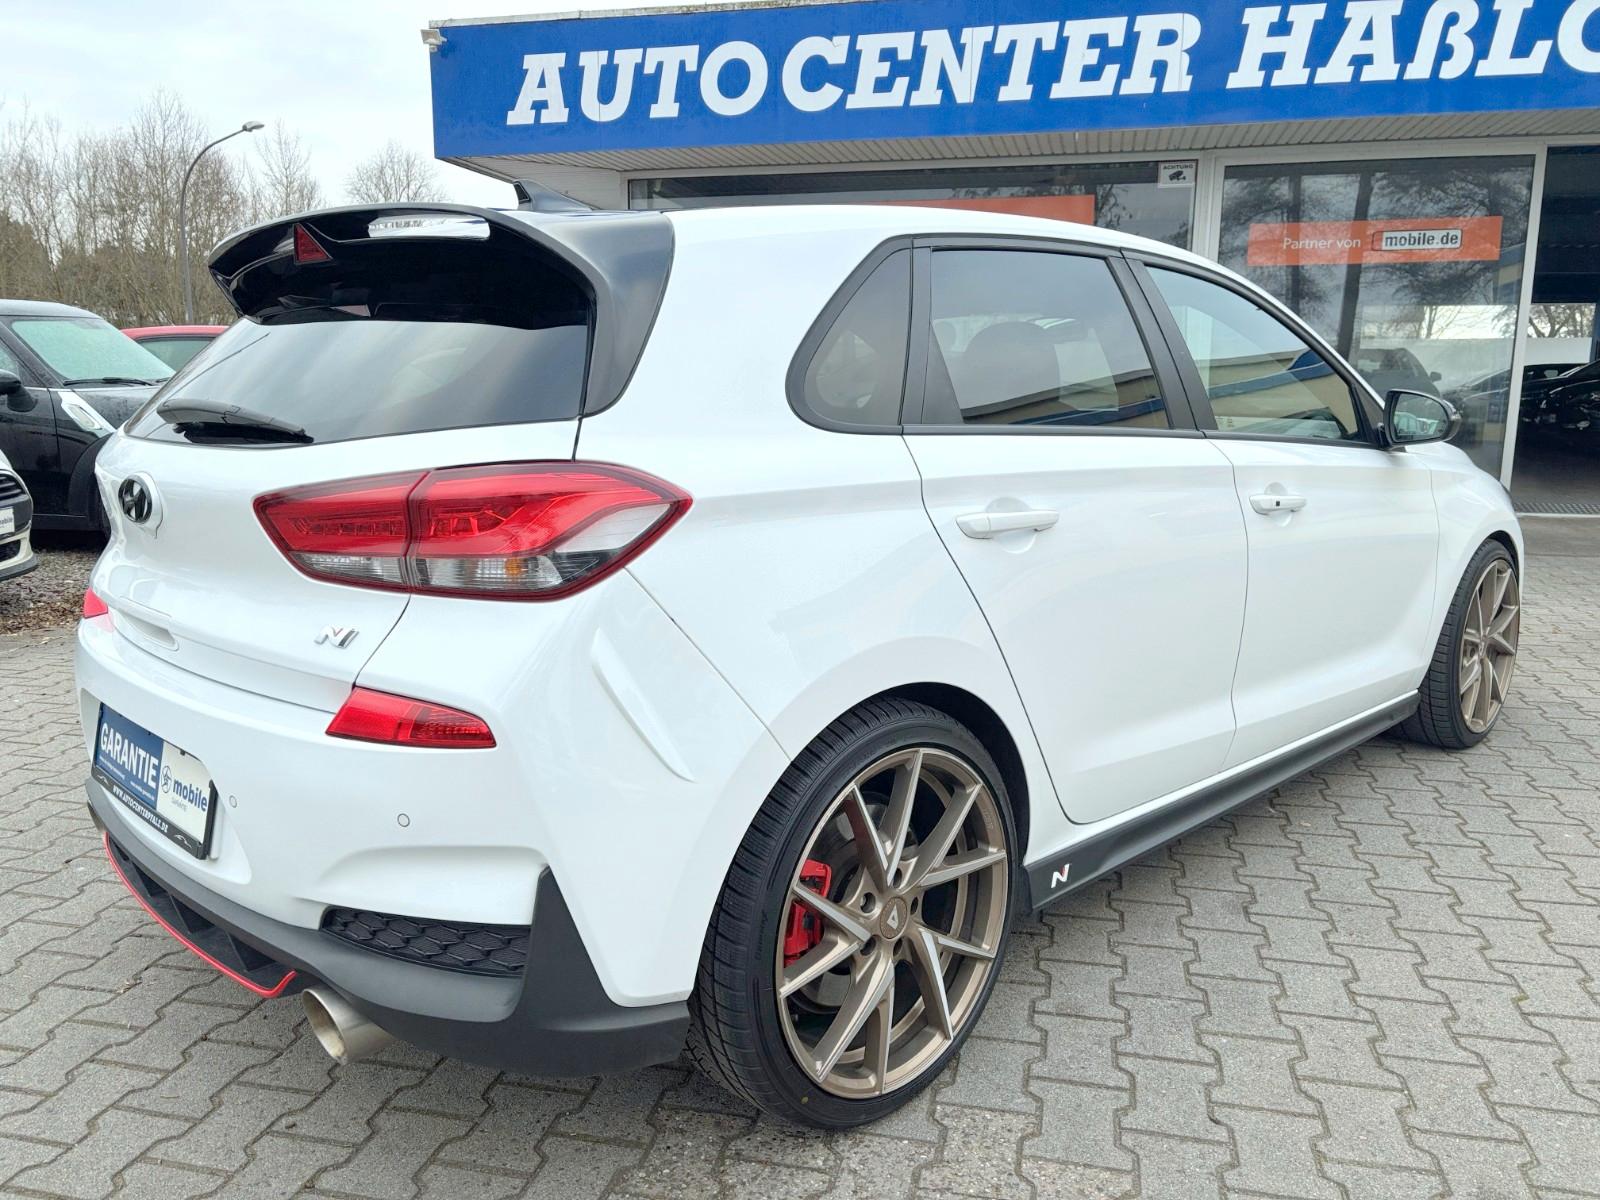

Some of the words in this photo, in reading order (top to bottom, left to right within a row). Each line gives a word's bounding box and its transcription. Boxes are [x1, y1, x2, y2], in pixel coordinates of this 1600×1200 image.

[506, 12, 1202, 126] AUTOCENTER
[1282, 237, 1334, 251] Partner
[1335, 238, 1361, 249] von
[1384, 232, 1459, 248] mobile.de
[101, 722, 159, 790] GARANTIE
[172, 778, 208, 812] mobile
[1051, 863, 1070, 889] N
